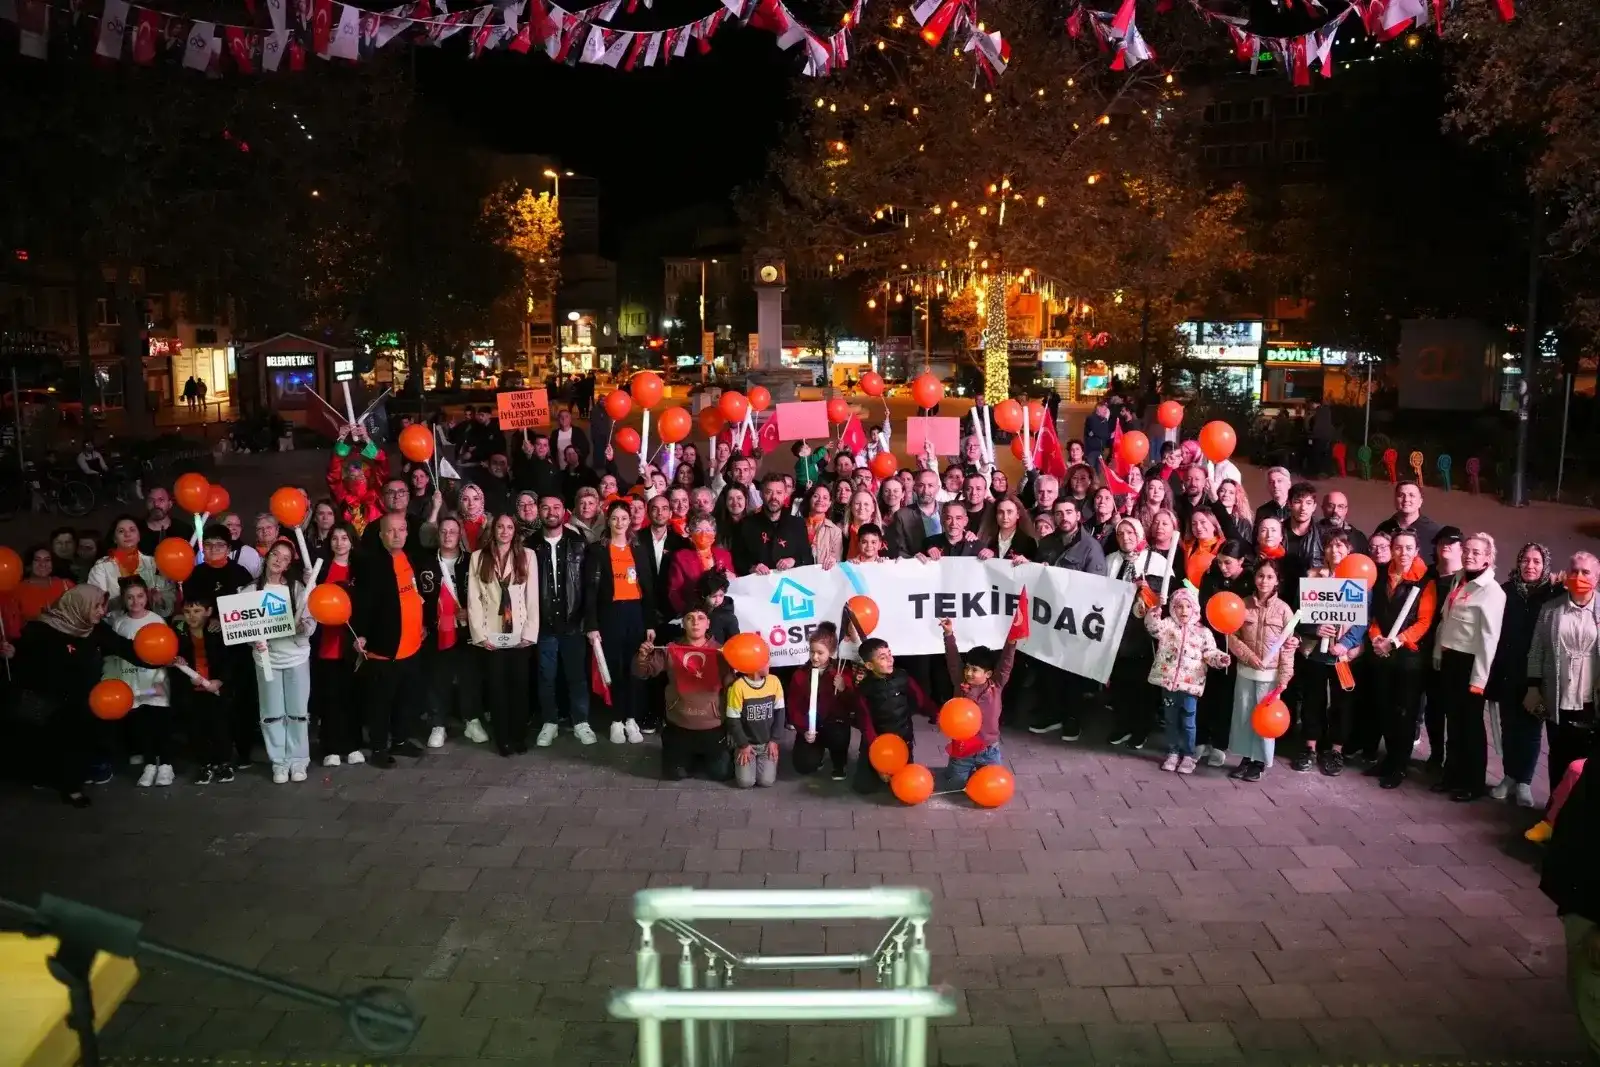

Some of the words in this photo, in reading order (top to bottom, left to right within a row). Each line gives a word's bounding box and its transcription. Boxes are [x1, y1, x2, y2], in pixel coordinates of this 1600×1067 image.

[511, 392, 533, 400] UMUT
[511, 401, 535, 409] VARSA
[500, 408, 548, 420] İYİLEŞME'DE
[1301, 590, 1344, 602] LÖSEV
[222, 607, 266, 624] LÖSEV
[1310, 611, 1356, 623] ÇORLU
[226, 628, 262, 640] İSTANBUL
[263, 623, 293, 635] AVRUPA
